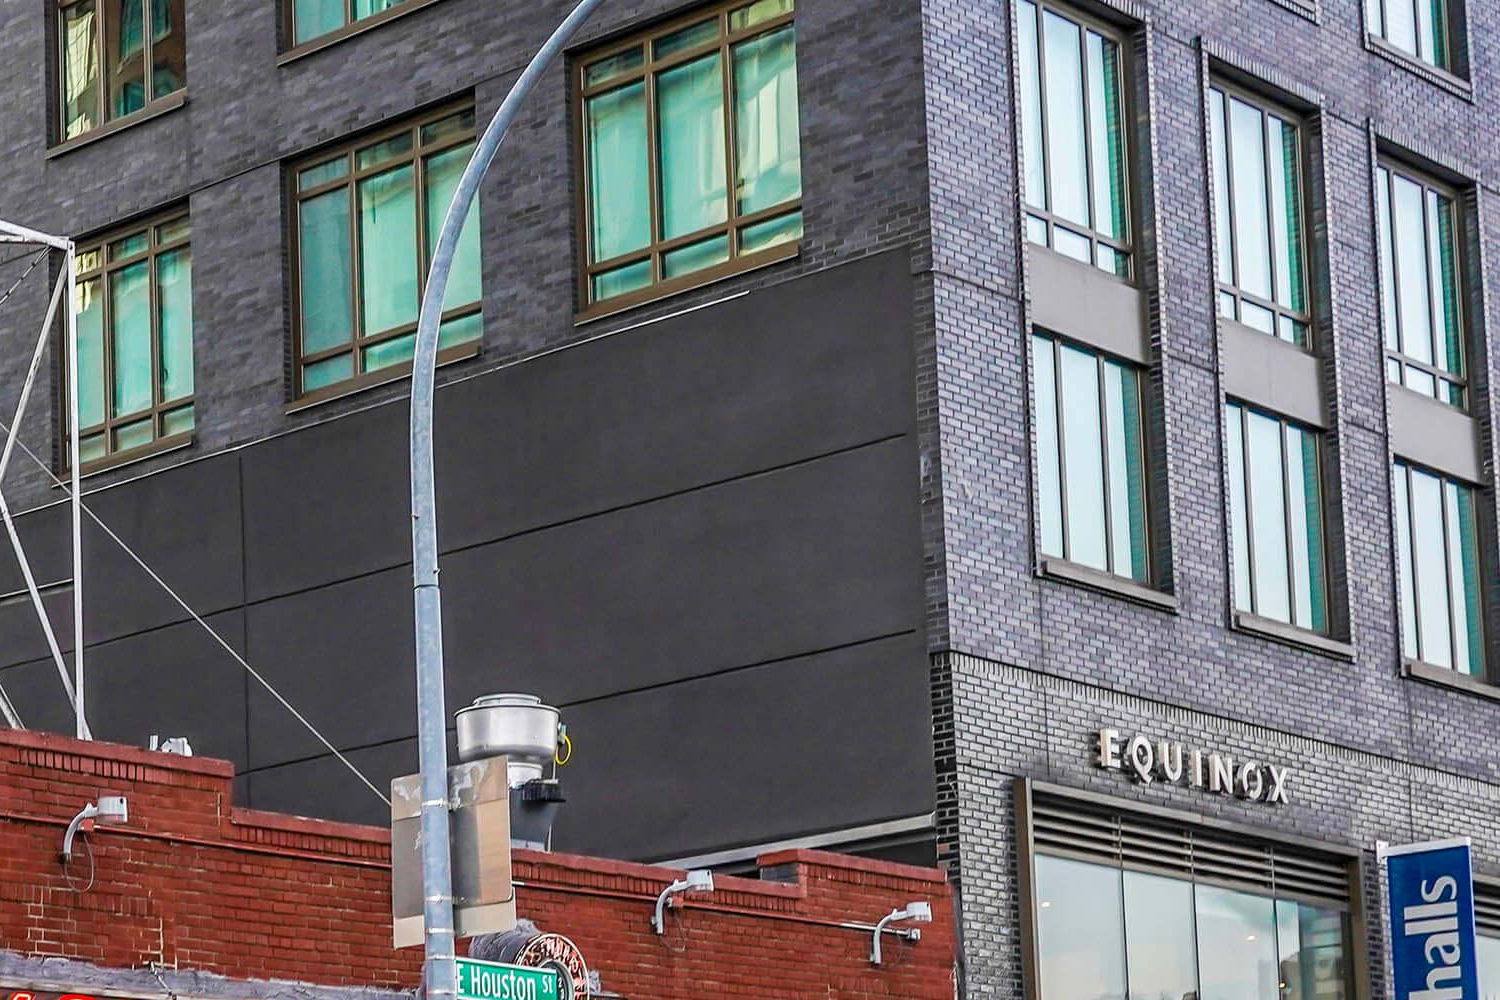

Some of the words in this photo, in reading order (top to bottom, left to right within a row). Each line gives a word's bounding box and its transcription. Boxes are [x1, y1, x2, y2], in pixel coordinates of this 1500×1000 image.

[1097, 728, 1289, 803] EQUINOX
[456, 963, 464, 994] E
[542, 973, 554, 995] St
